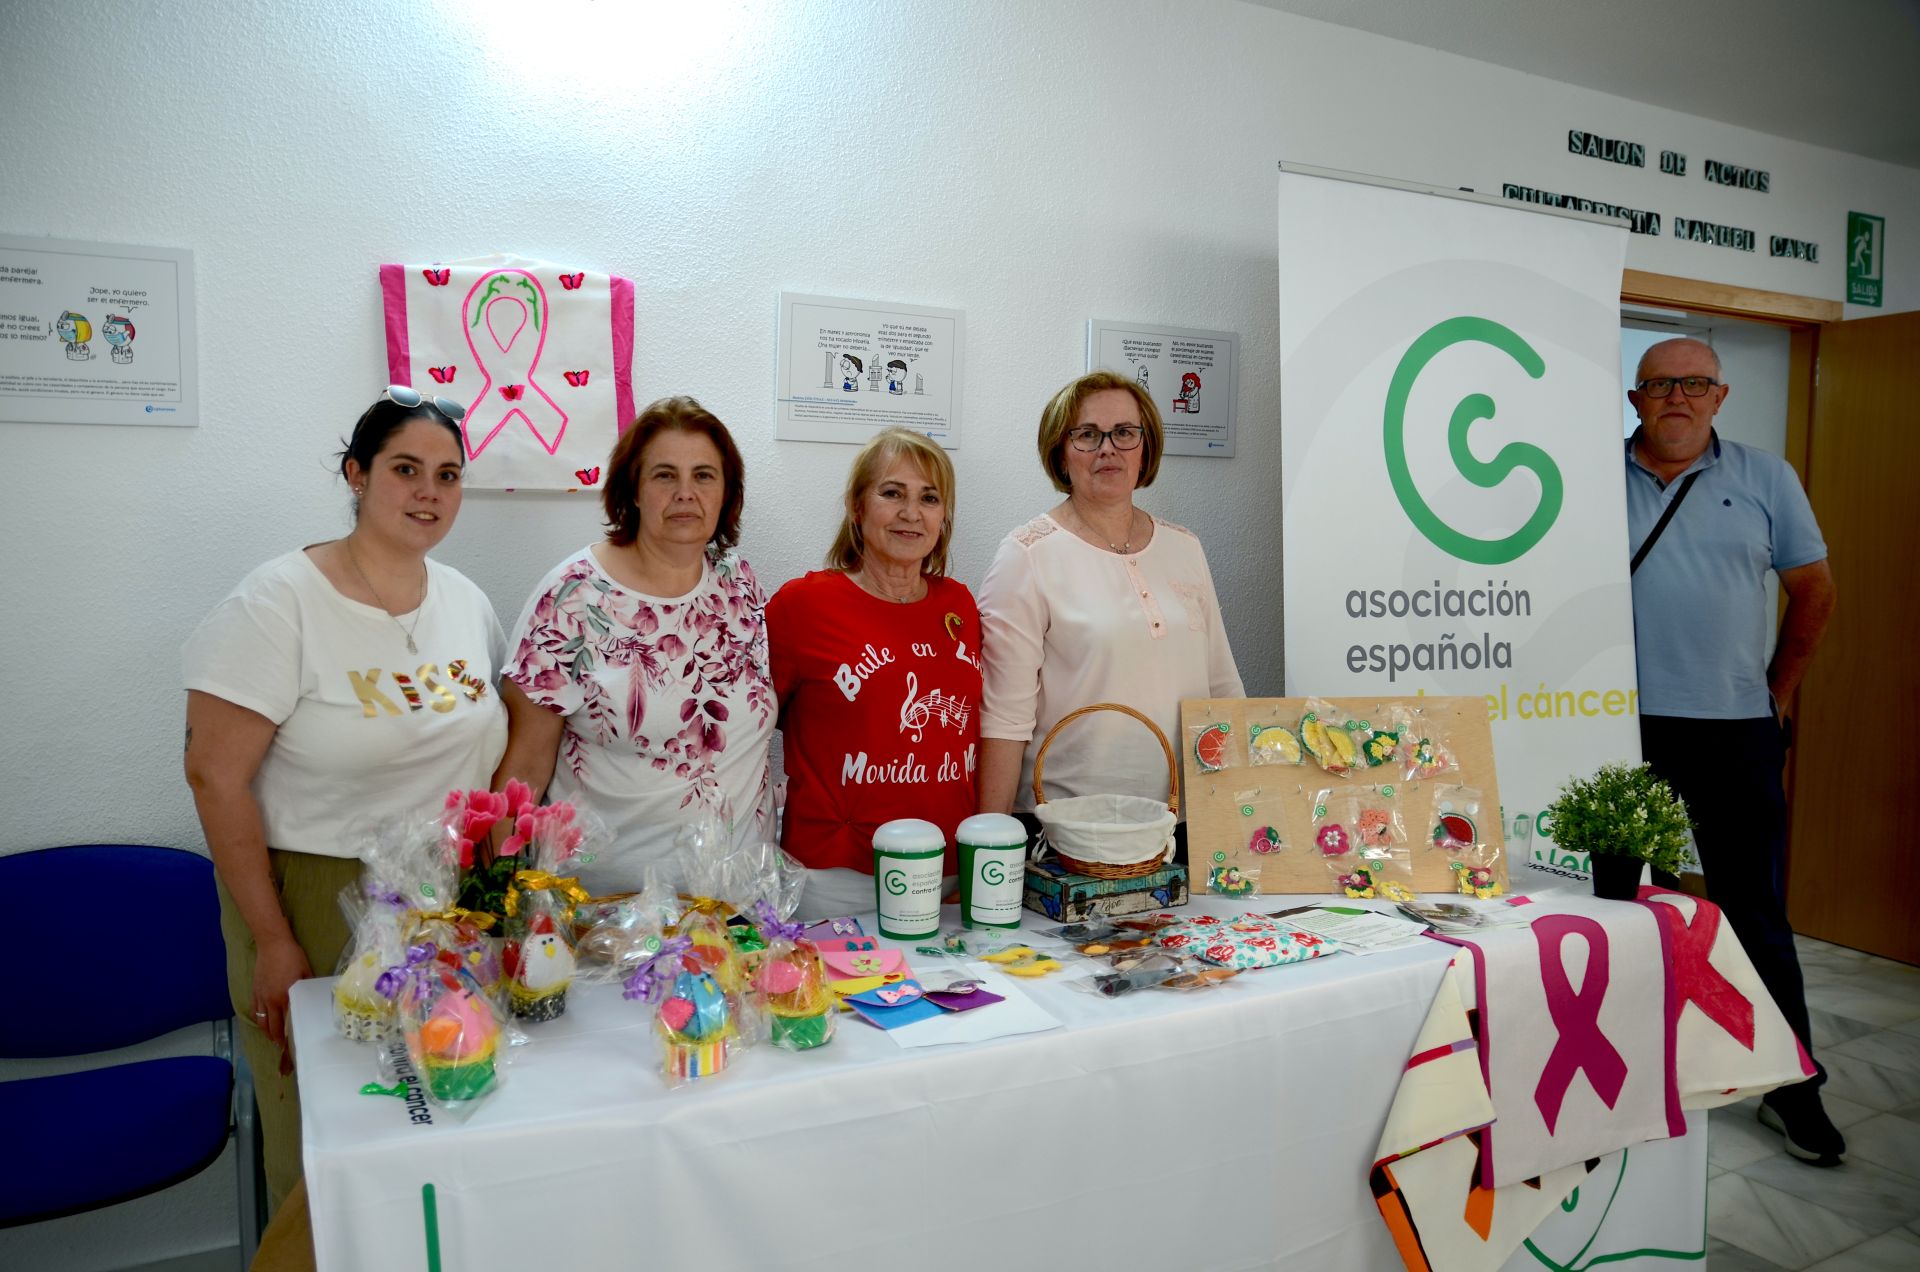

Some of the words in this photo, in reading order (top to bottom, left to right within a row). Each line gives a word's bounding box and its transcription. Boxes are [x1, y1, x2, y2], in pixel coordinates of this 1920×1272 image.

[1569, 130, 1645, 168] SALON
[1661, 151, 1687, 176] DE
[1705, 160, 1769, 192] ACTOS
[1675, 218, 1755, 252] MANUEL
[1852, 283, 1878, 298] SALIDA
[1345, 580, 1531, 618] asociación
[833, 643, 895, 702] Baile
[911, 643, 936, 657] en
[1346, 633, 1512, 682] española
[1486, 684, 1507, 722] el
[1517, 683, 1638, 720] cáncer
[842, 752, 929, 787] Movida
[937, 752, 961, 783] de
